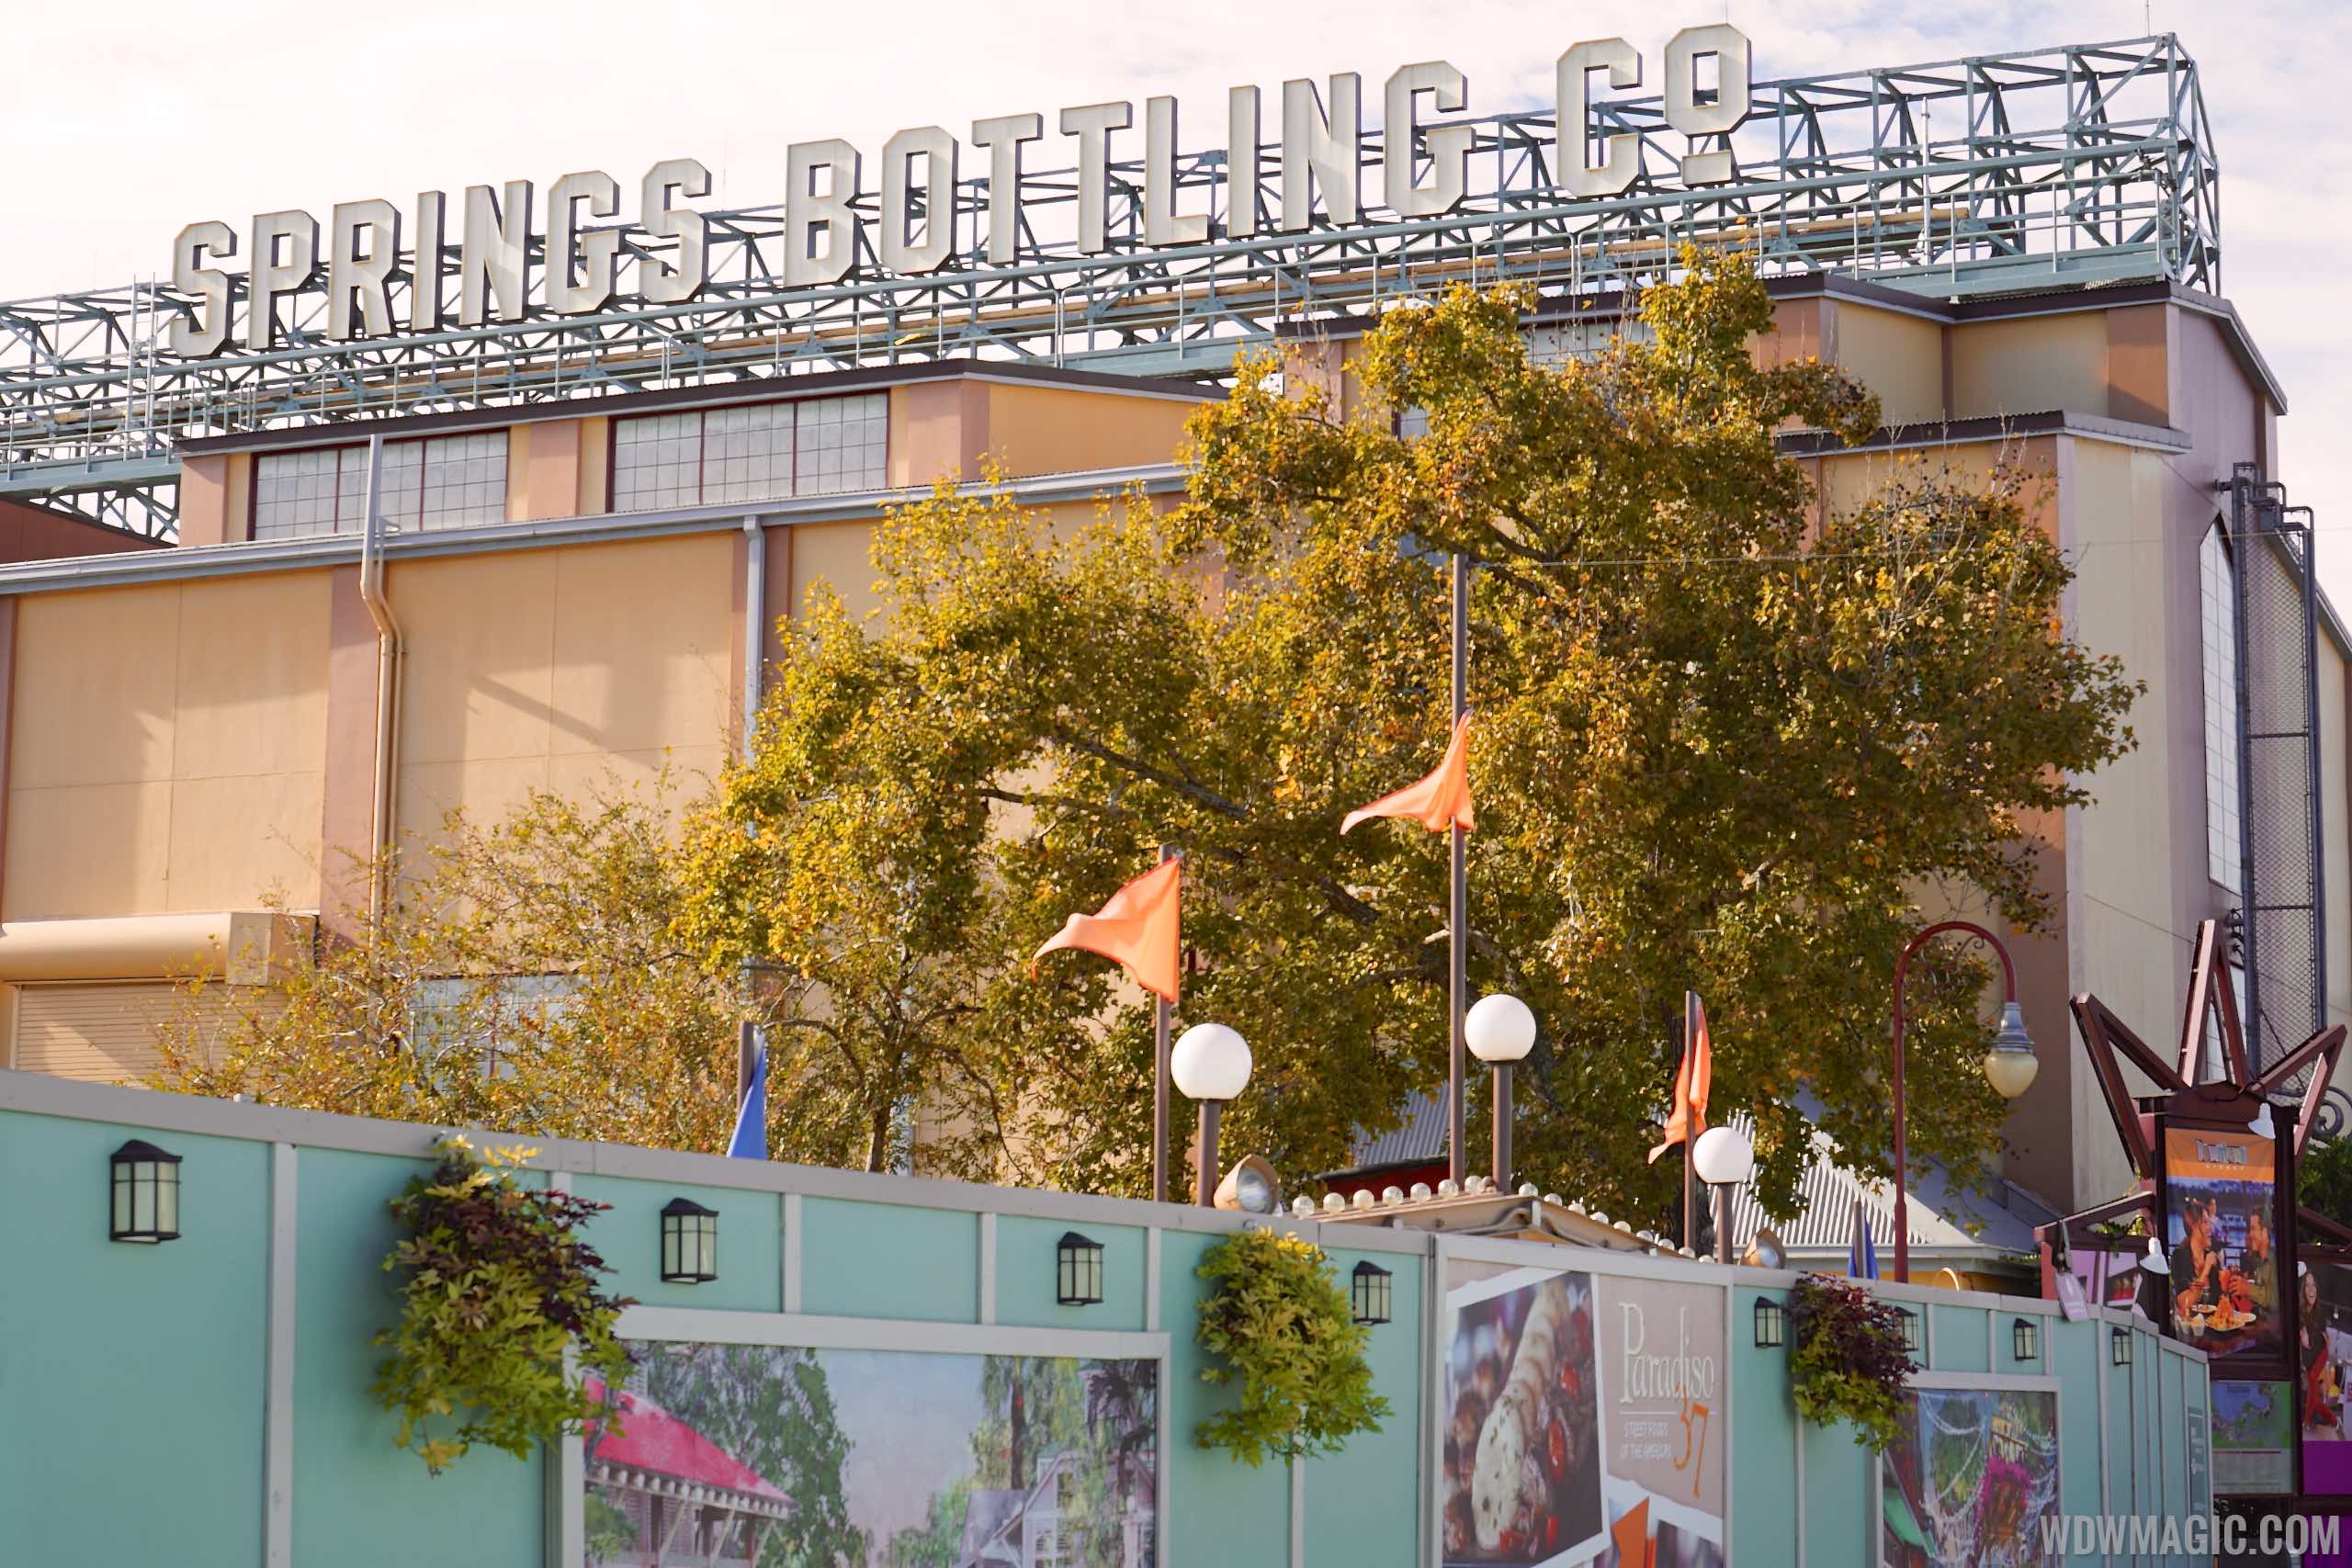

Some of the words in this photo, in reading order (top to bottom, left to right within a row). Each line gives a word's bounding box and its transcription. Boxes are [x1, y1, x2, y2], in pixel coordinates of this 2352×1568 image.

[171, 158, 713, 357] SPRINGS
[783, 60, 1475, 287] BOTTLING
[1619, 1302, 1714, 1404] Paradiso
[1674, 1382, 1709, 1499] 37
